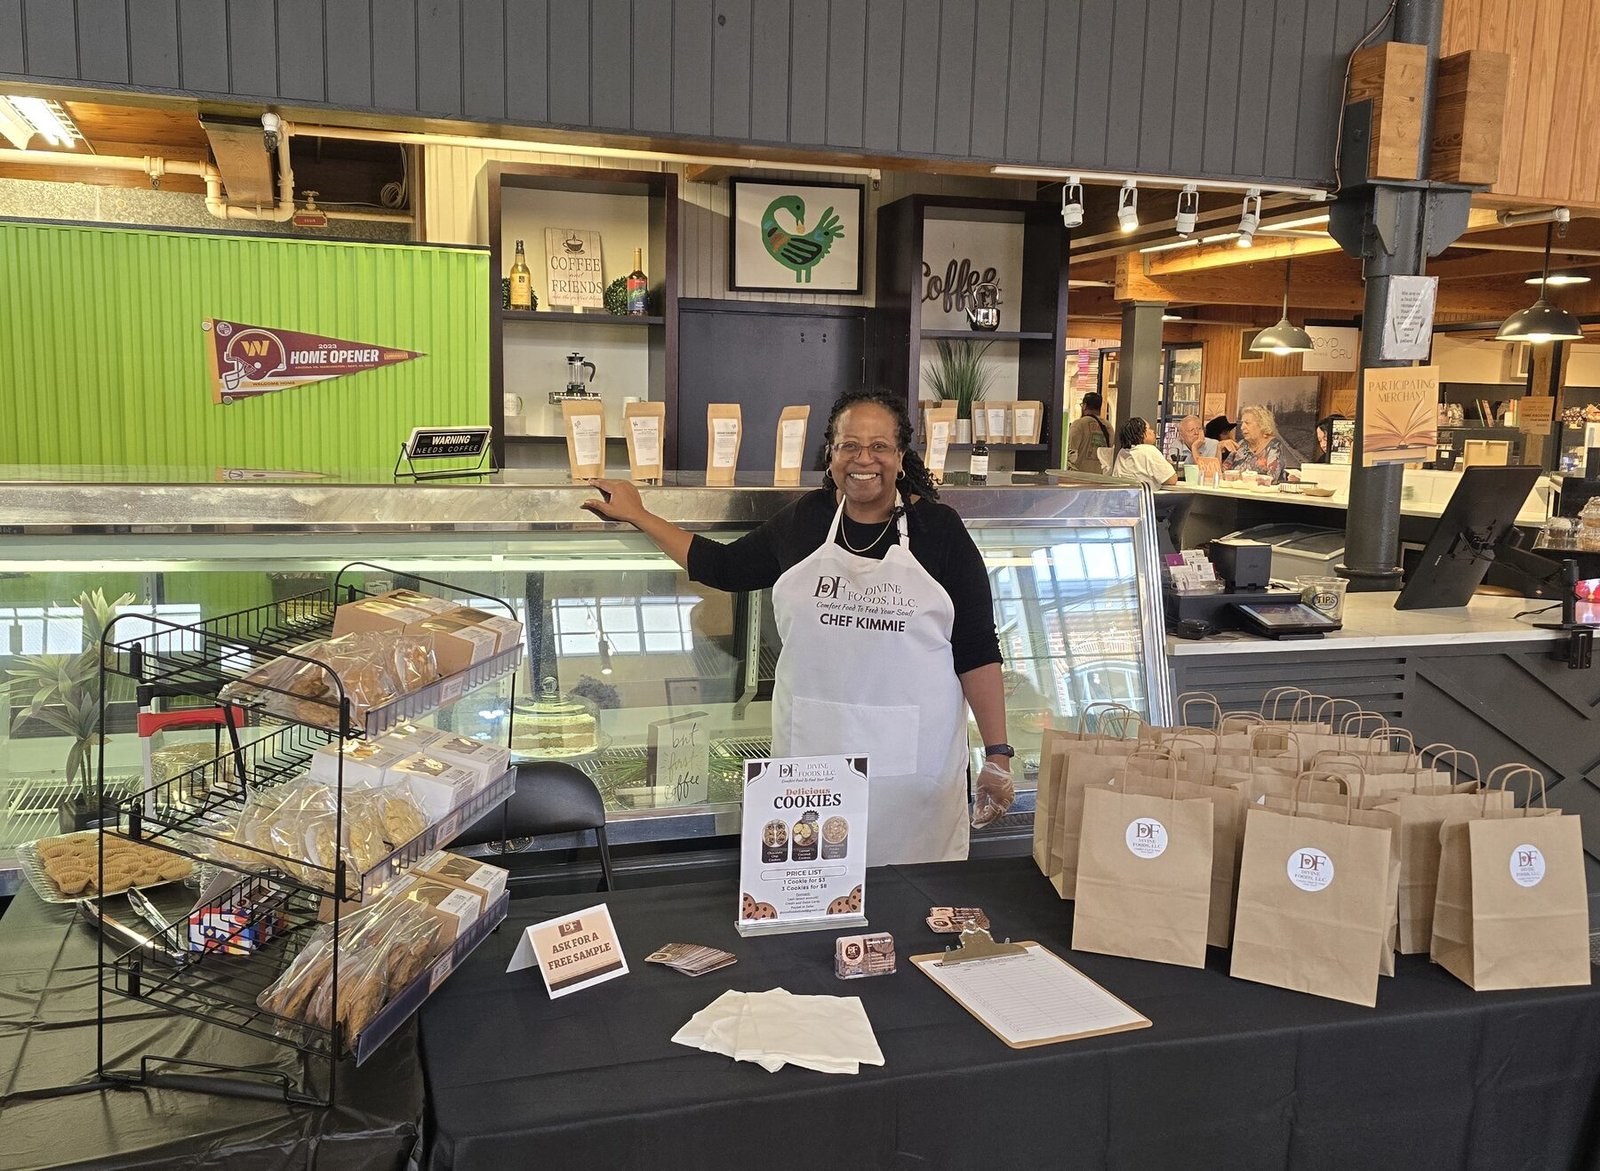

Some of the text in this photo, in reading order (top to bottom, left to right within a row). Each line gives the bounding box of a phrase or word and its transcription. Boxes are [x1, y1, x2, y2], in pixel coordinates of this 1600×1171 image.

[551, 255, 600, 271] COFFEE
[552, 280, 603, 294] FRIENDS
[290, 350, 328, 365] HOME
[329, 349, 379, 364] OPENER
[1368, 379, 1436, 391] PARTICIPATING
[1378, 390, 1427, 403] MERCHANT
[432, 435, 471, 445] WARNING
[416, 446, 443, 454] NEEDS
[812, 575, 851, 599] DF
[864, 582, 902, 596] DIVINE
[848, 591, 919, 608] FOODS, LLC.
[1317, 596, 1336, 604] TIPS
[816, 601, 841, 610] Comfort
[842, 603, 856, 612] Food
[864, 606, 879, 614] Feed
[880, 607, 895, 615] Your
[820, 613, 906, 632] CHEF KIMMIE
[785, 787, 831, 796] Delicious
[773, 793, 842, 809] COOKIES
[1136, 822, 1161, 838] DF
[1298, 852, 1327, 871] DF
[1518, 850, 1538, 867] DF
[552, 931, 600, 954] ASK FOR A
[547, 942, 612, 971] FREE SAMPLE
